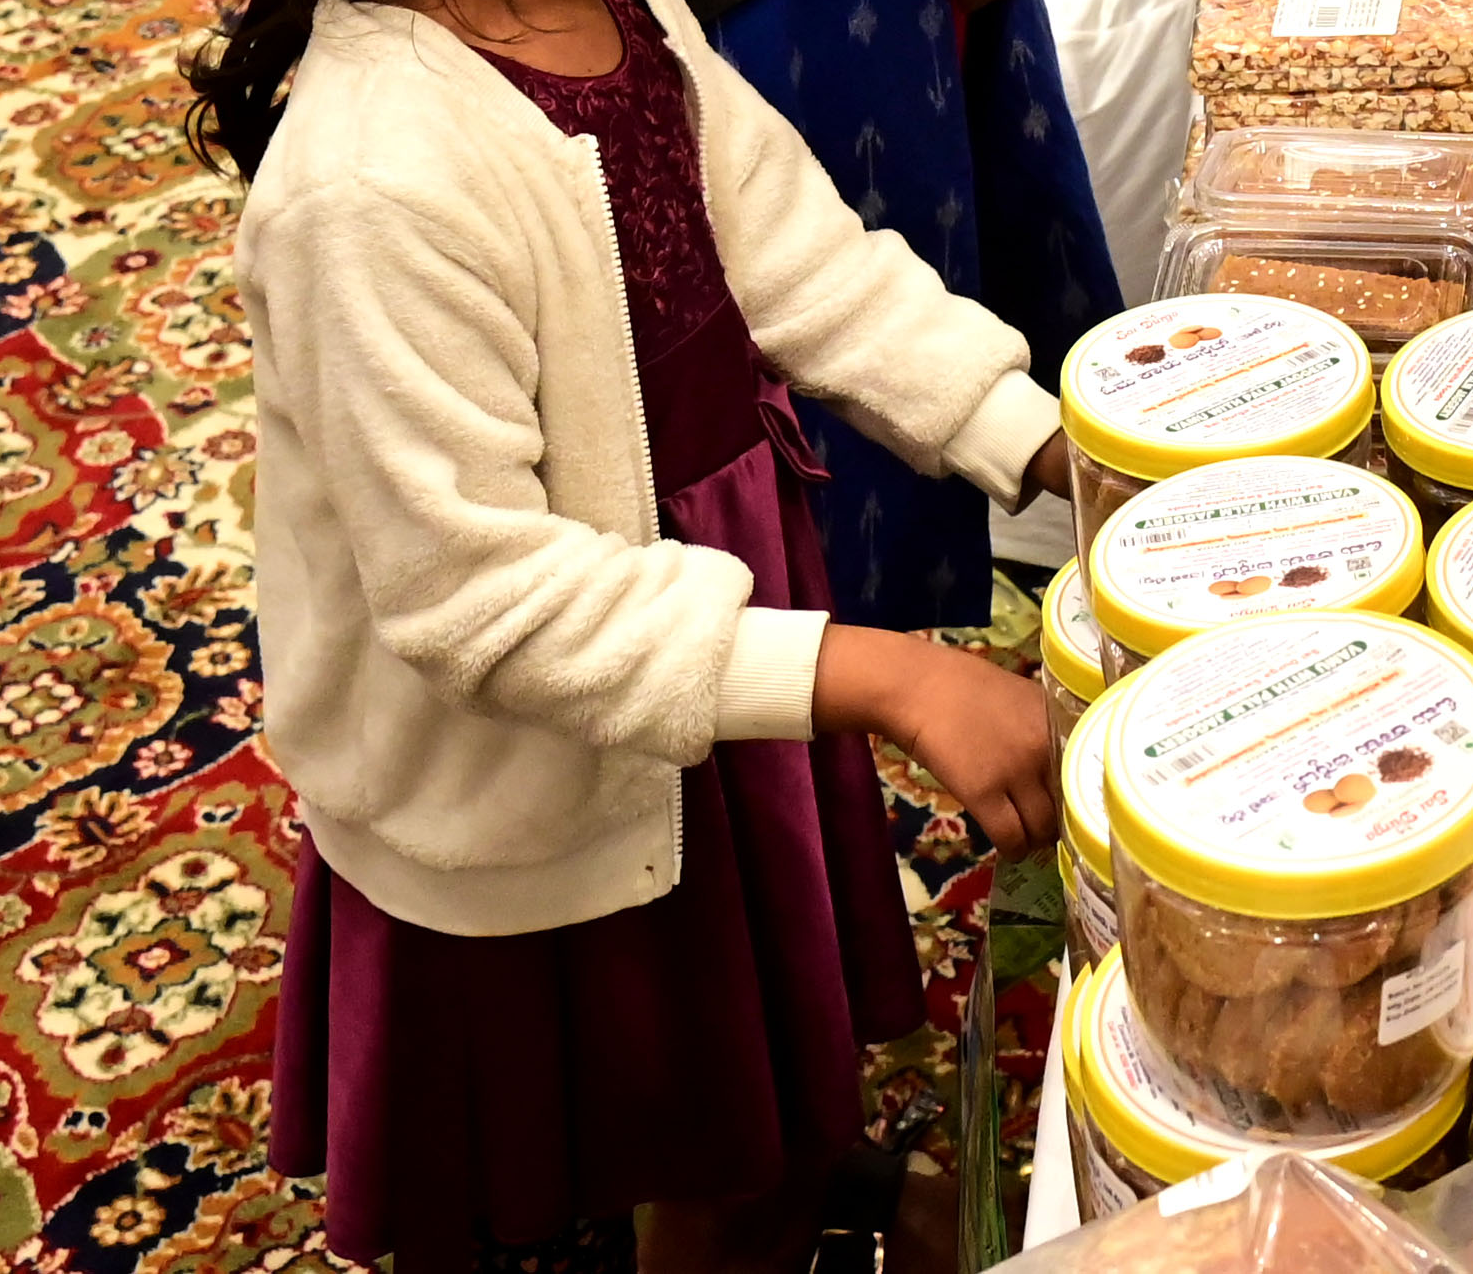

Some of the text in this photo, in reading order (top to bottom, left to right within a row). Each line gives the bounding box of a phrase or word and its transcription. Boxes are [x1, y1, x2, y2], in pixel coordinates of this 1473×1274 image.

[1145, 641, 1367, 756] VAMU WITH PALM JAGGERY
[1358, 789, 1455, 845] Sai Durga
